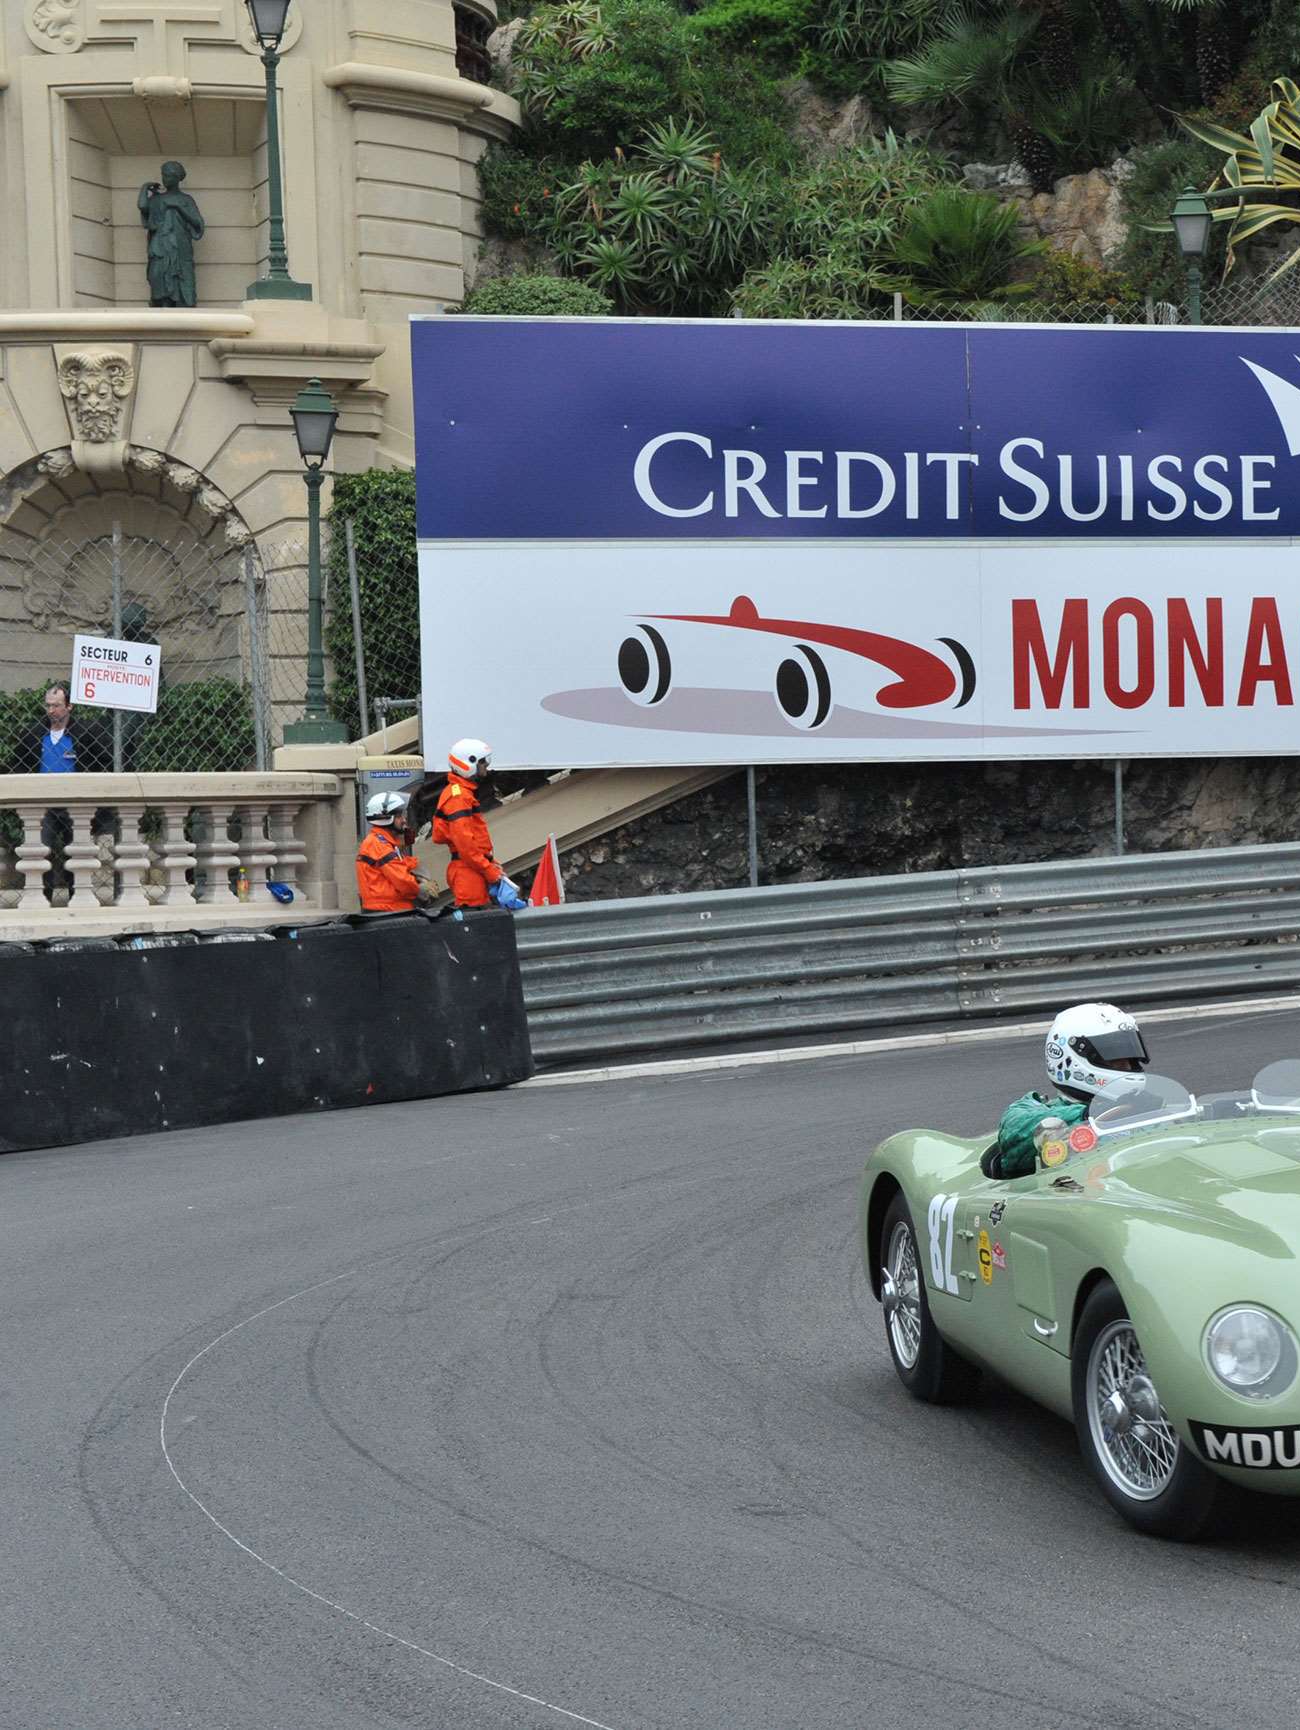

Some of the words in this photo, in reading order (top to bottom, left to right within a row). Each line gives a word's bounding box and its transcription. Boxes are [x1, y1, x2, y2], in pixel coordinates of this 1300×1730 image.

[633, 430, 980, 520] CREDIT
[998, 436, 1281, 522] SUISSE
[81, 645, 128, 662] SECTEUR
[144, 654, 153, 666] 6
[80, 667, 152, 687] INTERVENTION
[84, 682, 96, 698] 6
[928, 1192, 960, 1295] 82
